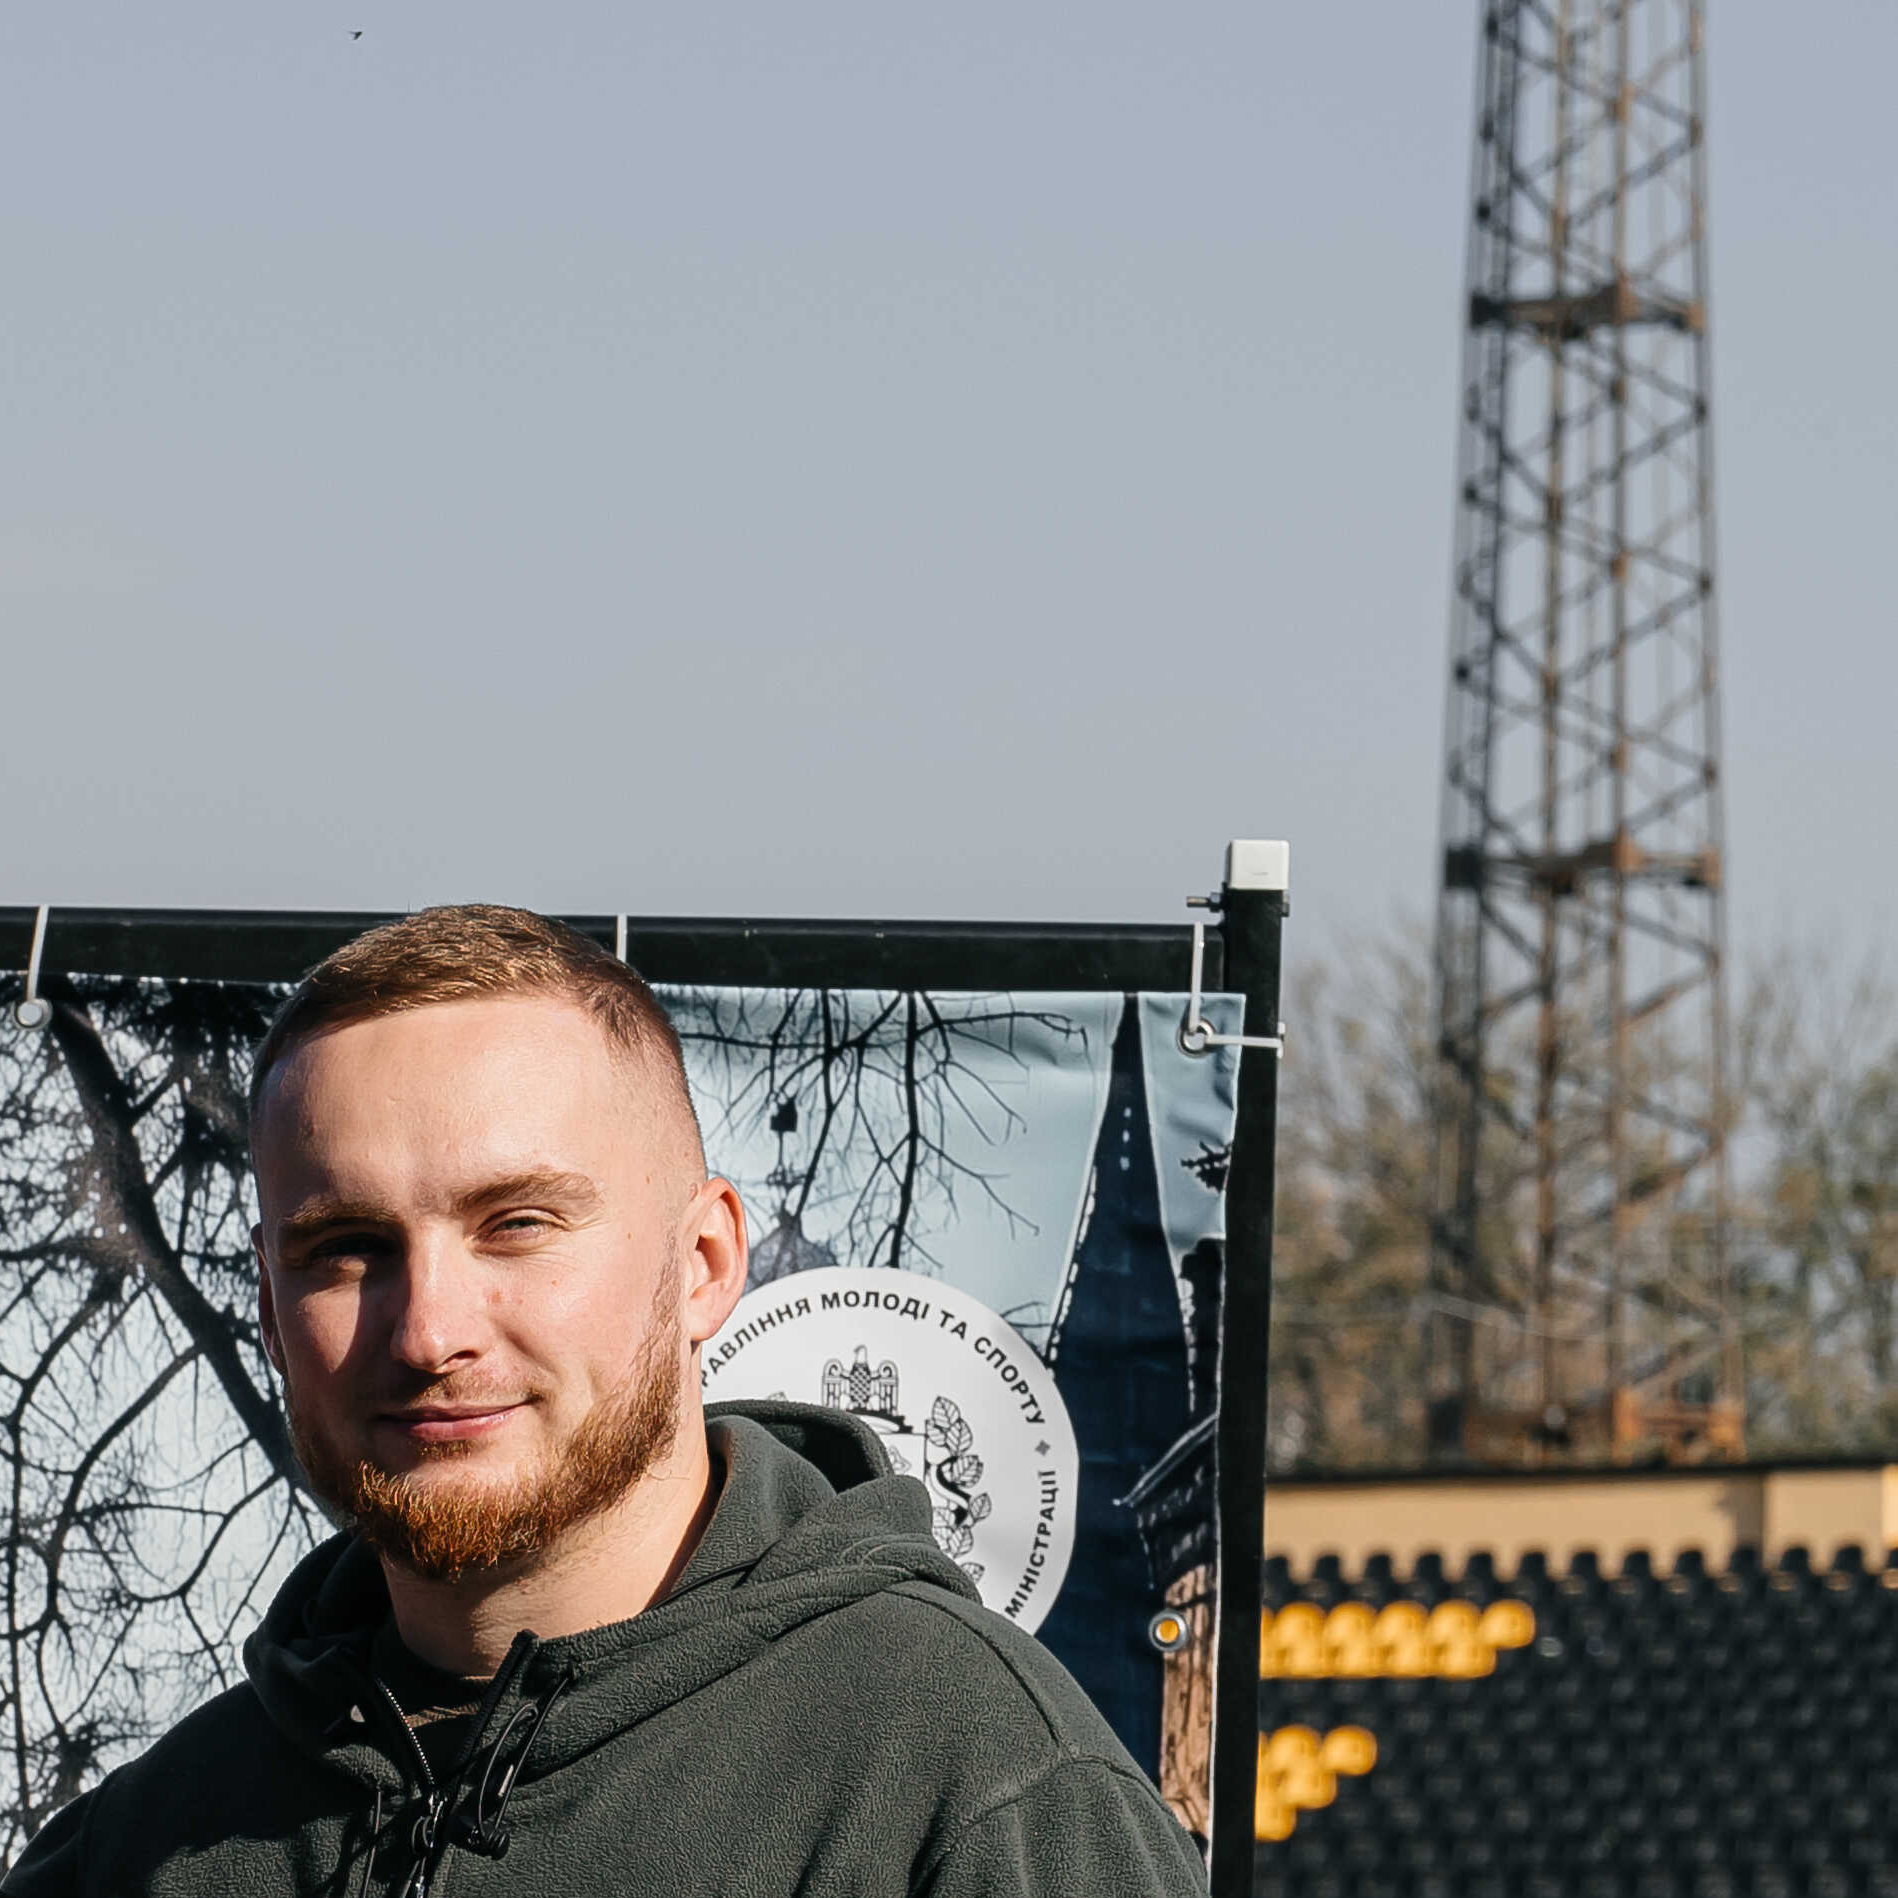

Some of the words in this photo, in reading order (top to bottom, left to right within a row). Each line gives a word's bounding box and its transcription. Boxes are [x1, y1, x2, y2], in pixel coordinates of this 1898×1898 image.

[820, 1290, 929, 1321] МОЛОДІ
[937, 1310, 968, 1341] ТА
[973, 1336, 1046, 1427] СПОРТУ
[1004, 1470, 1059, 1618] МІНІСТРАЦІЇ
